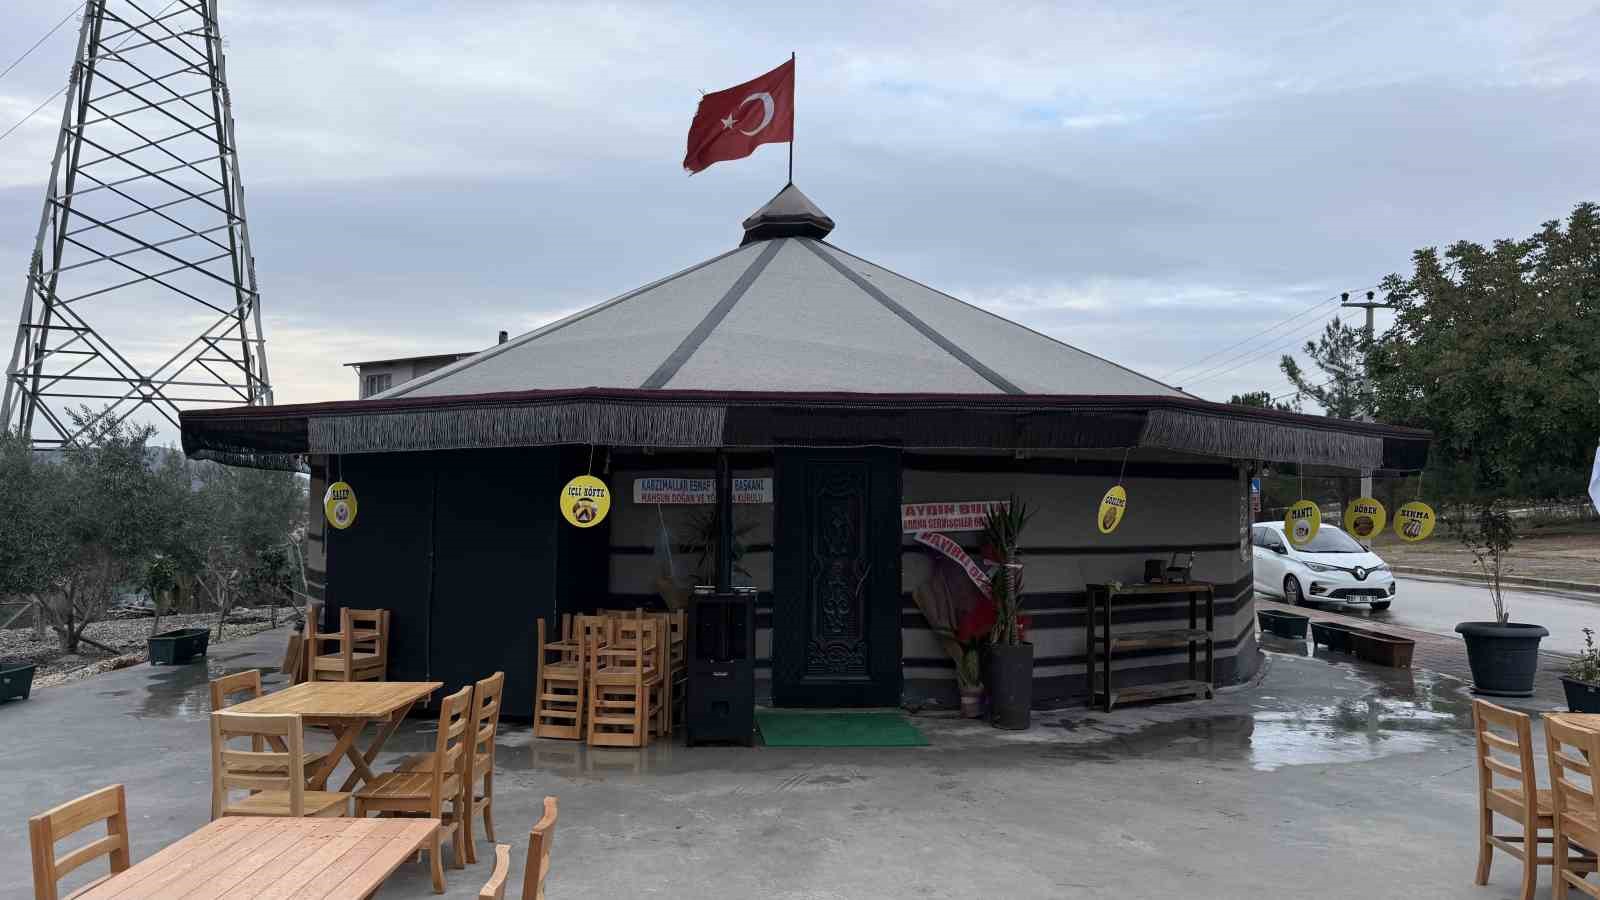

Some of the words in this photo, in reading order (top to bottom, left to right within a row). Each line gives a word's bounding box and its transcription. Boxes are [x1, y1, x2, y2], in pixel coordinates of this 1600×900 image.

[330, 488, 351, 500] SALEP
[584, 486, 605, 498] KÖFTE
[905, 503, 955, 516] AYDIN
[1292, 506, 1313, 519] MANTI
[1354, 504, 1377, 515] BÖREK
